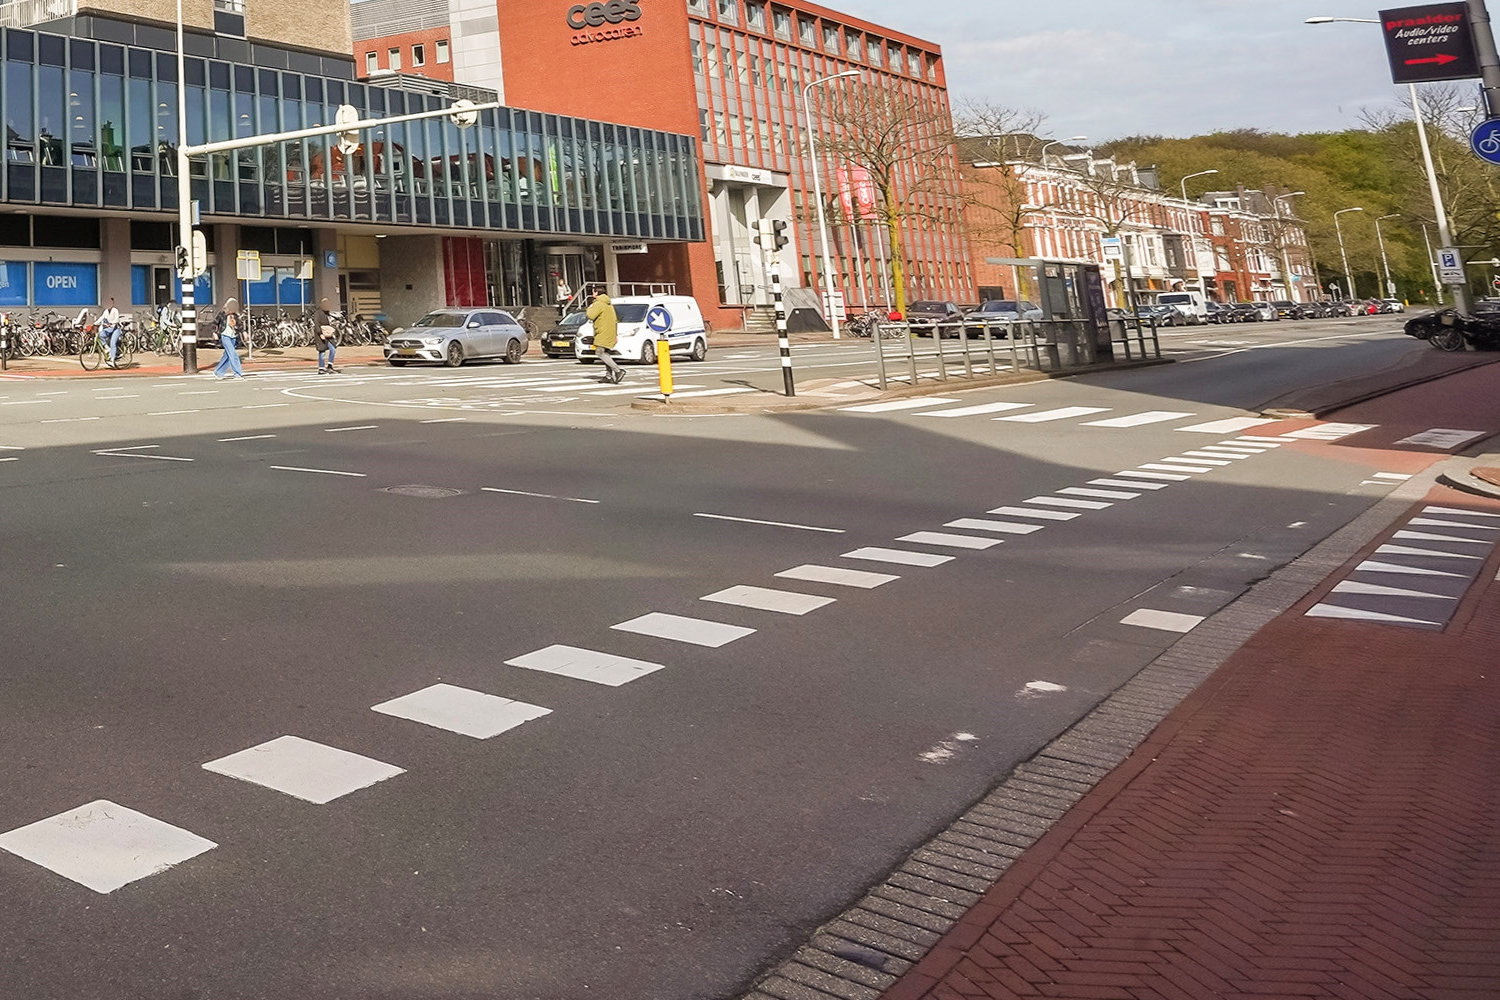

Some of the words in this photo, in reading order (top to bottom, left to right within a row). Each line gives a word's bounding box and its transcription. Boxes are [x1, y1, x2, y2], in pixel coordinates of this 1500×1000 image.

[1395, 24, 1459, 38] Audio/video
[1407, 34, 1449, 45] centers
[46, 275, 77, 289] OPEN
